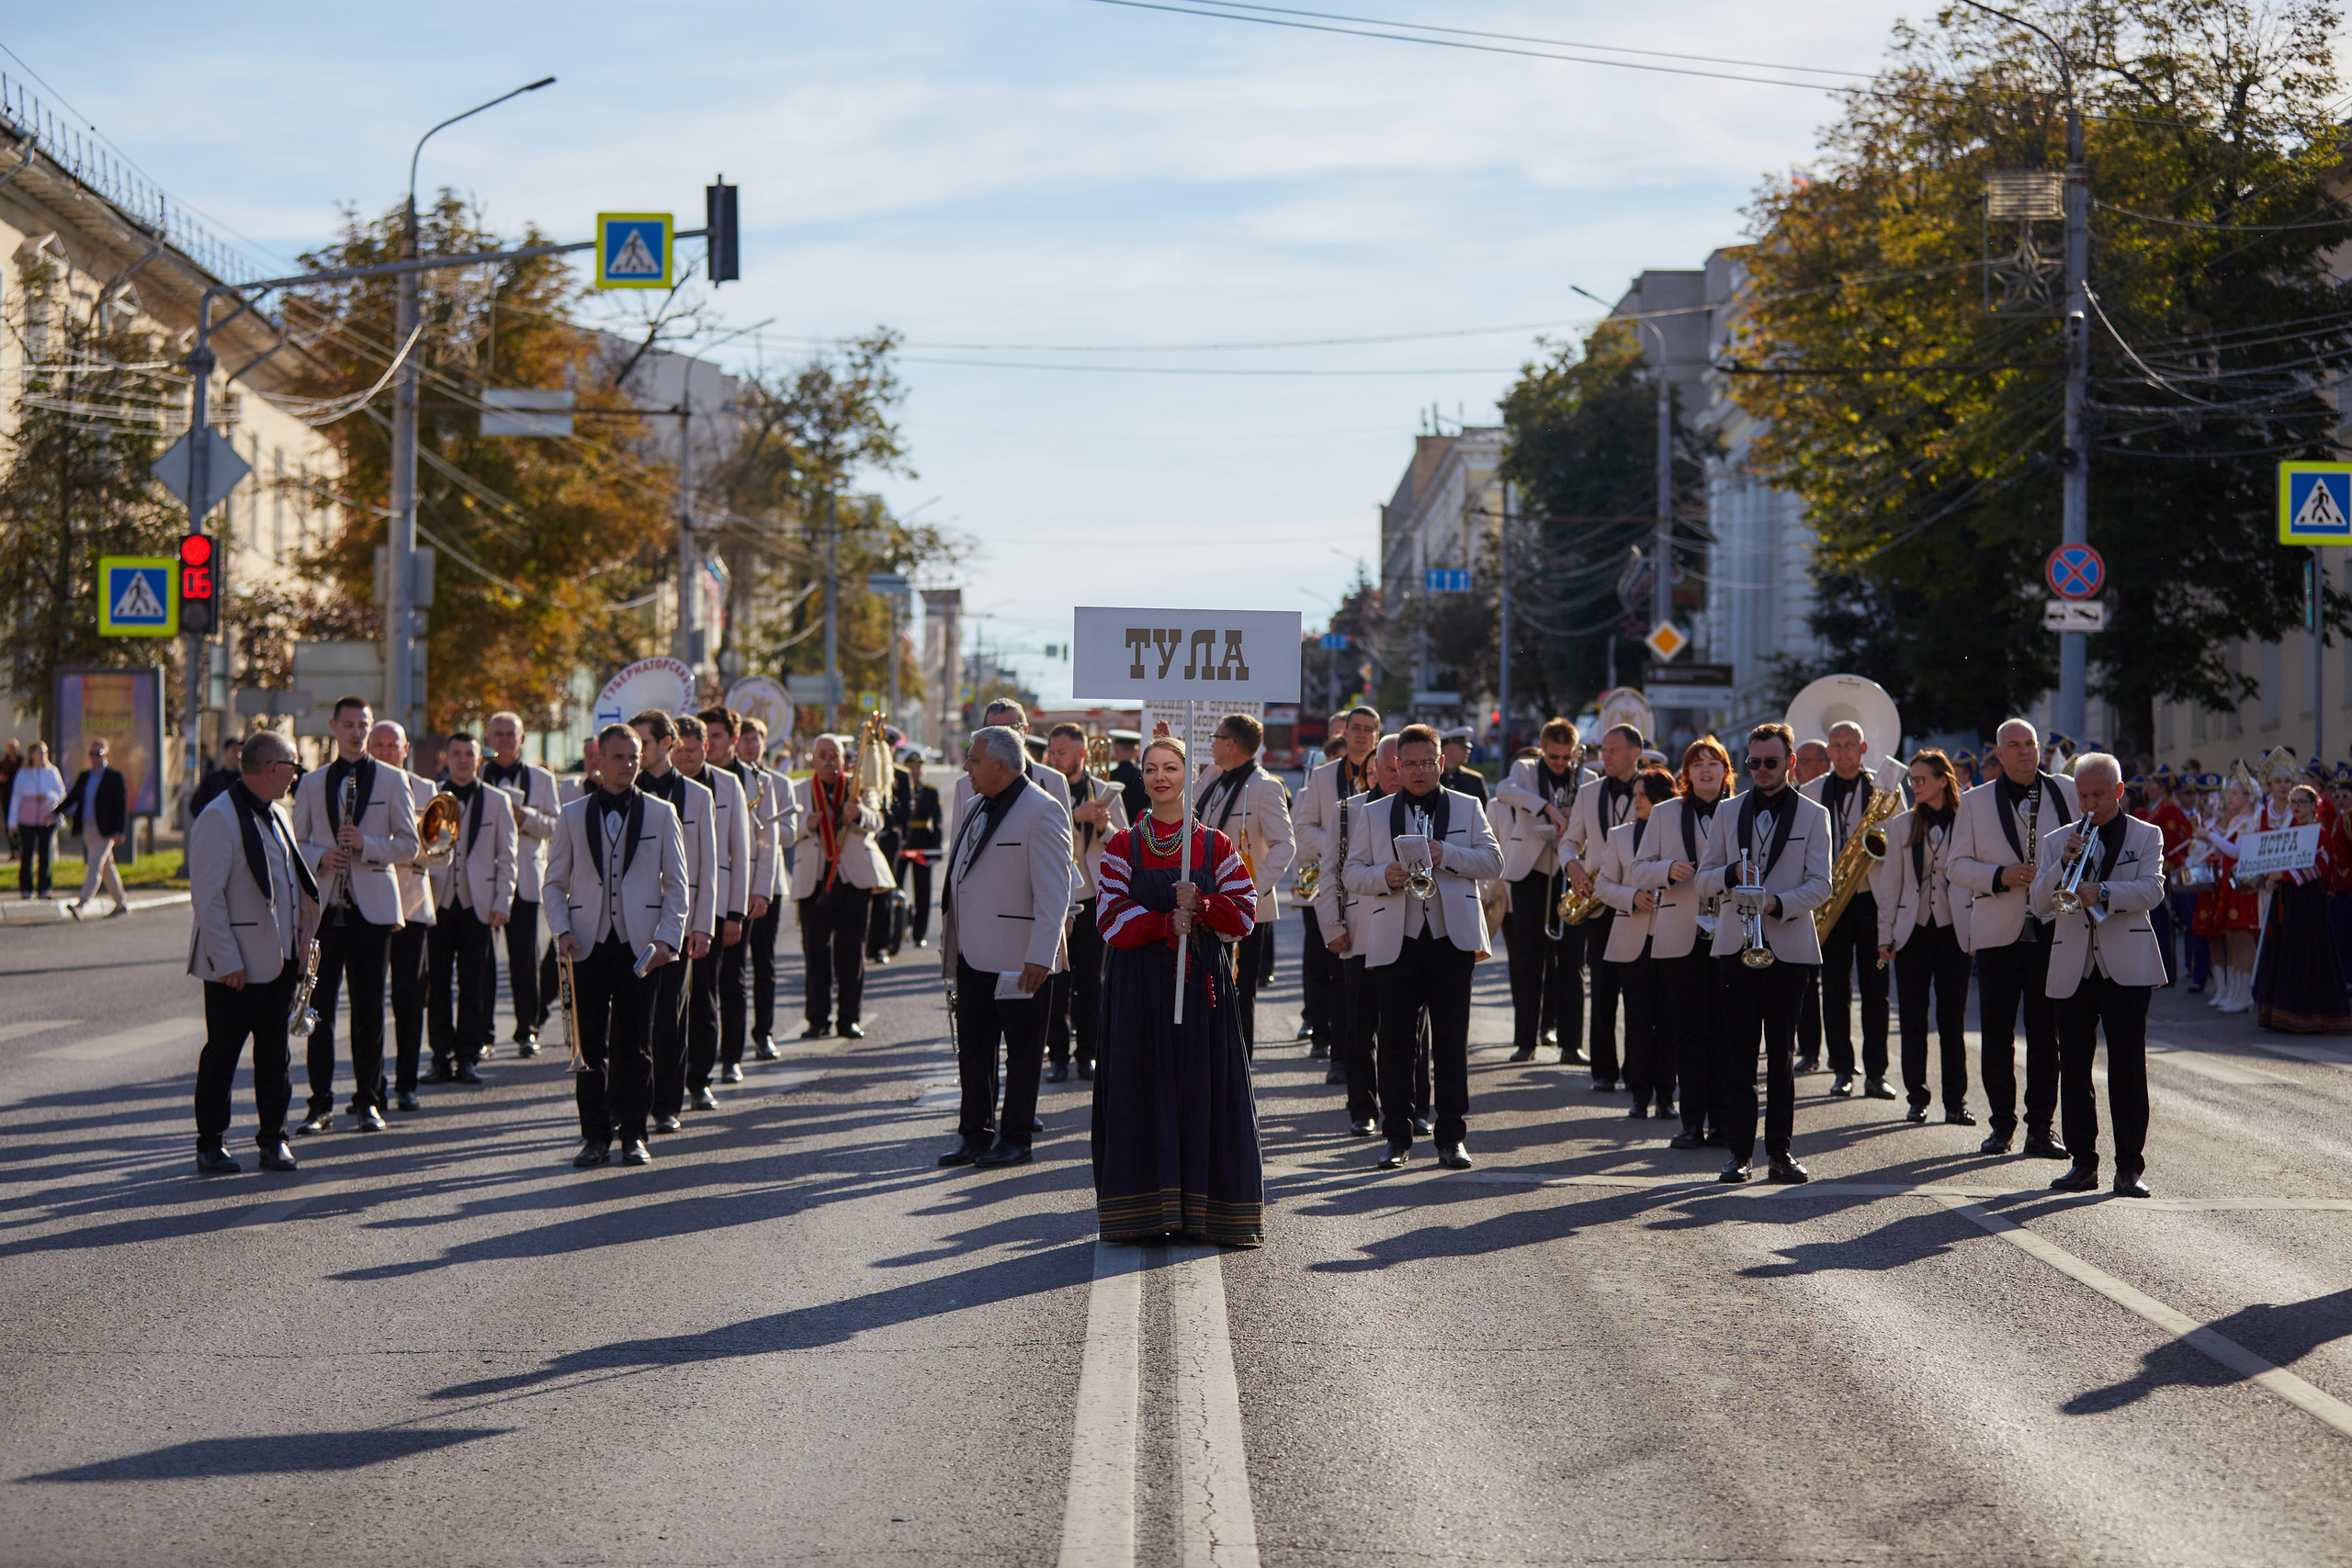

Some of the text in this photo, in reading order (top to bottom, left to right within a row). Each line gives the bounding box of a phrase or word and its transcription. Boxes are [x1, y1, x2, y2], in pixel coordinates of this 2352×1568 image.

[183, 567, 212, 599] 06
[1125, 628, 1250, 681] ТУЛА
[1209, 700, 1261, 714] ОРКЕСТР
[2258, 830, 2299, 856] ИСТРА
[2239, 851, 2314, 874] Московская обл.
